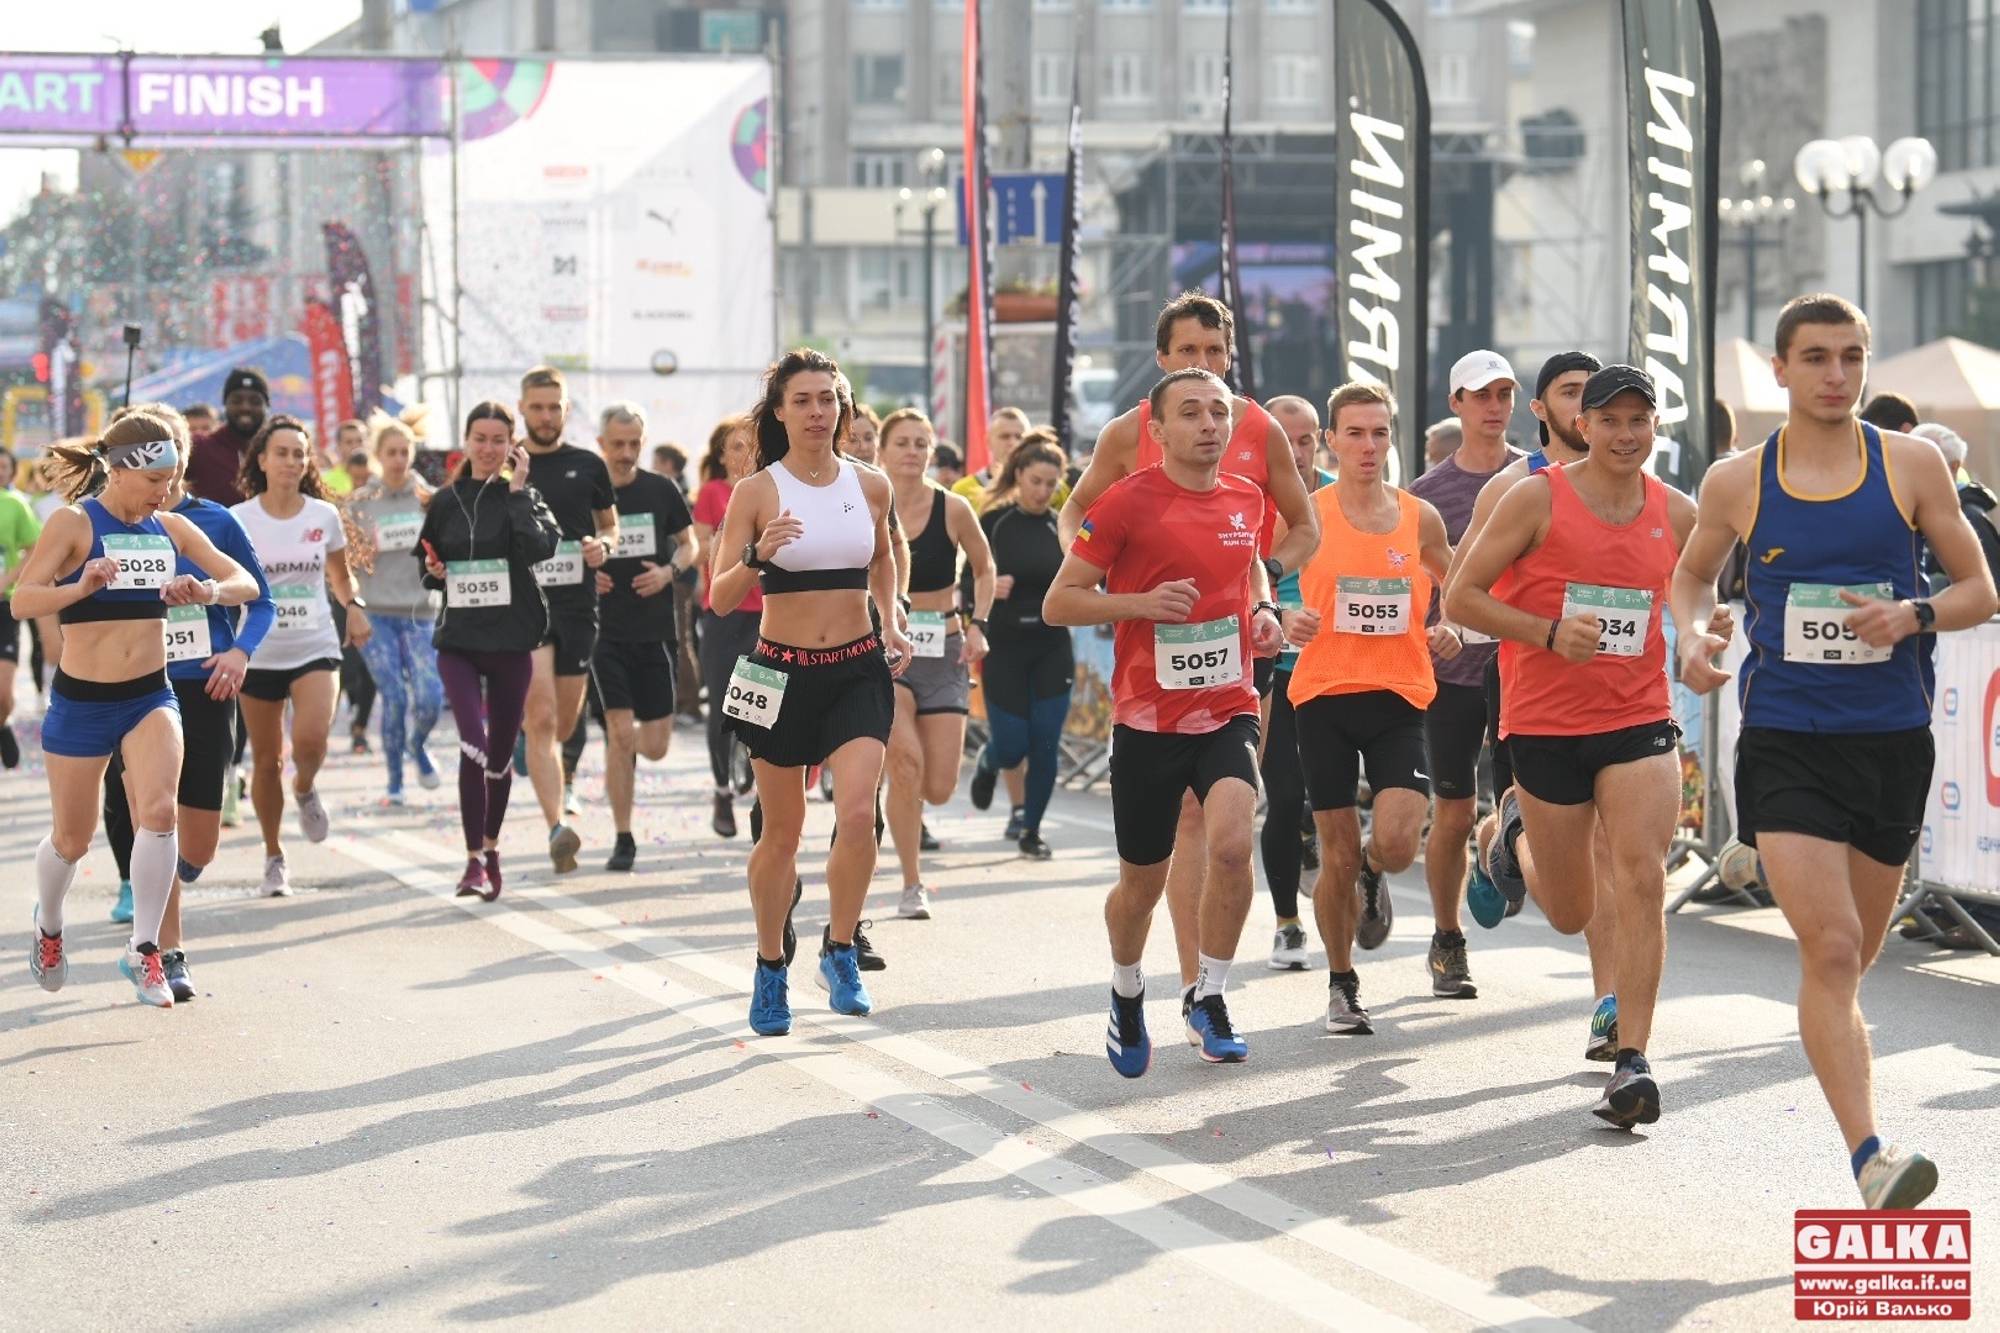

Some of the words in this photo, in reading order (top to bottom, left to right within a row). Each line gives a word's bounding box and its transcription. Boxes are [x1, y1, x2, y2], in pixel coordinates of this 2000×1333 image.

[0, 72, 104, 113] ART
[138, 72, 325, 117] FINISH
[618, 533, 645, 546] 032
[119, 558, 166, 573] 5028
[263, 561, 321, 574] ARMIN
[534, 561, 574, 574] 5029
[456, 581, 499, 594] 5035
[276, 606, 308, 617] 046
[1348, 603, 1398, 619] 5053
[1598, 618, 1636, 638] 034
[1802, 621, 1858, 641] 505
[166, 630, 195, 646] 051
[904, 632, 935, 644] 047
[810, 649, 845, 665] START
[1171, 648, 1228, 671] 5057
